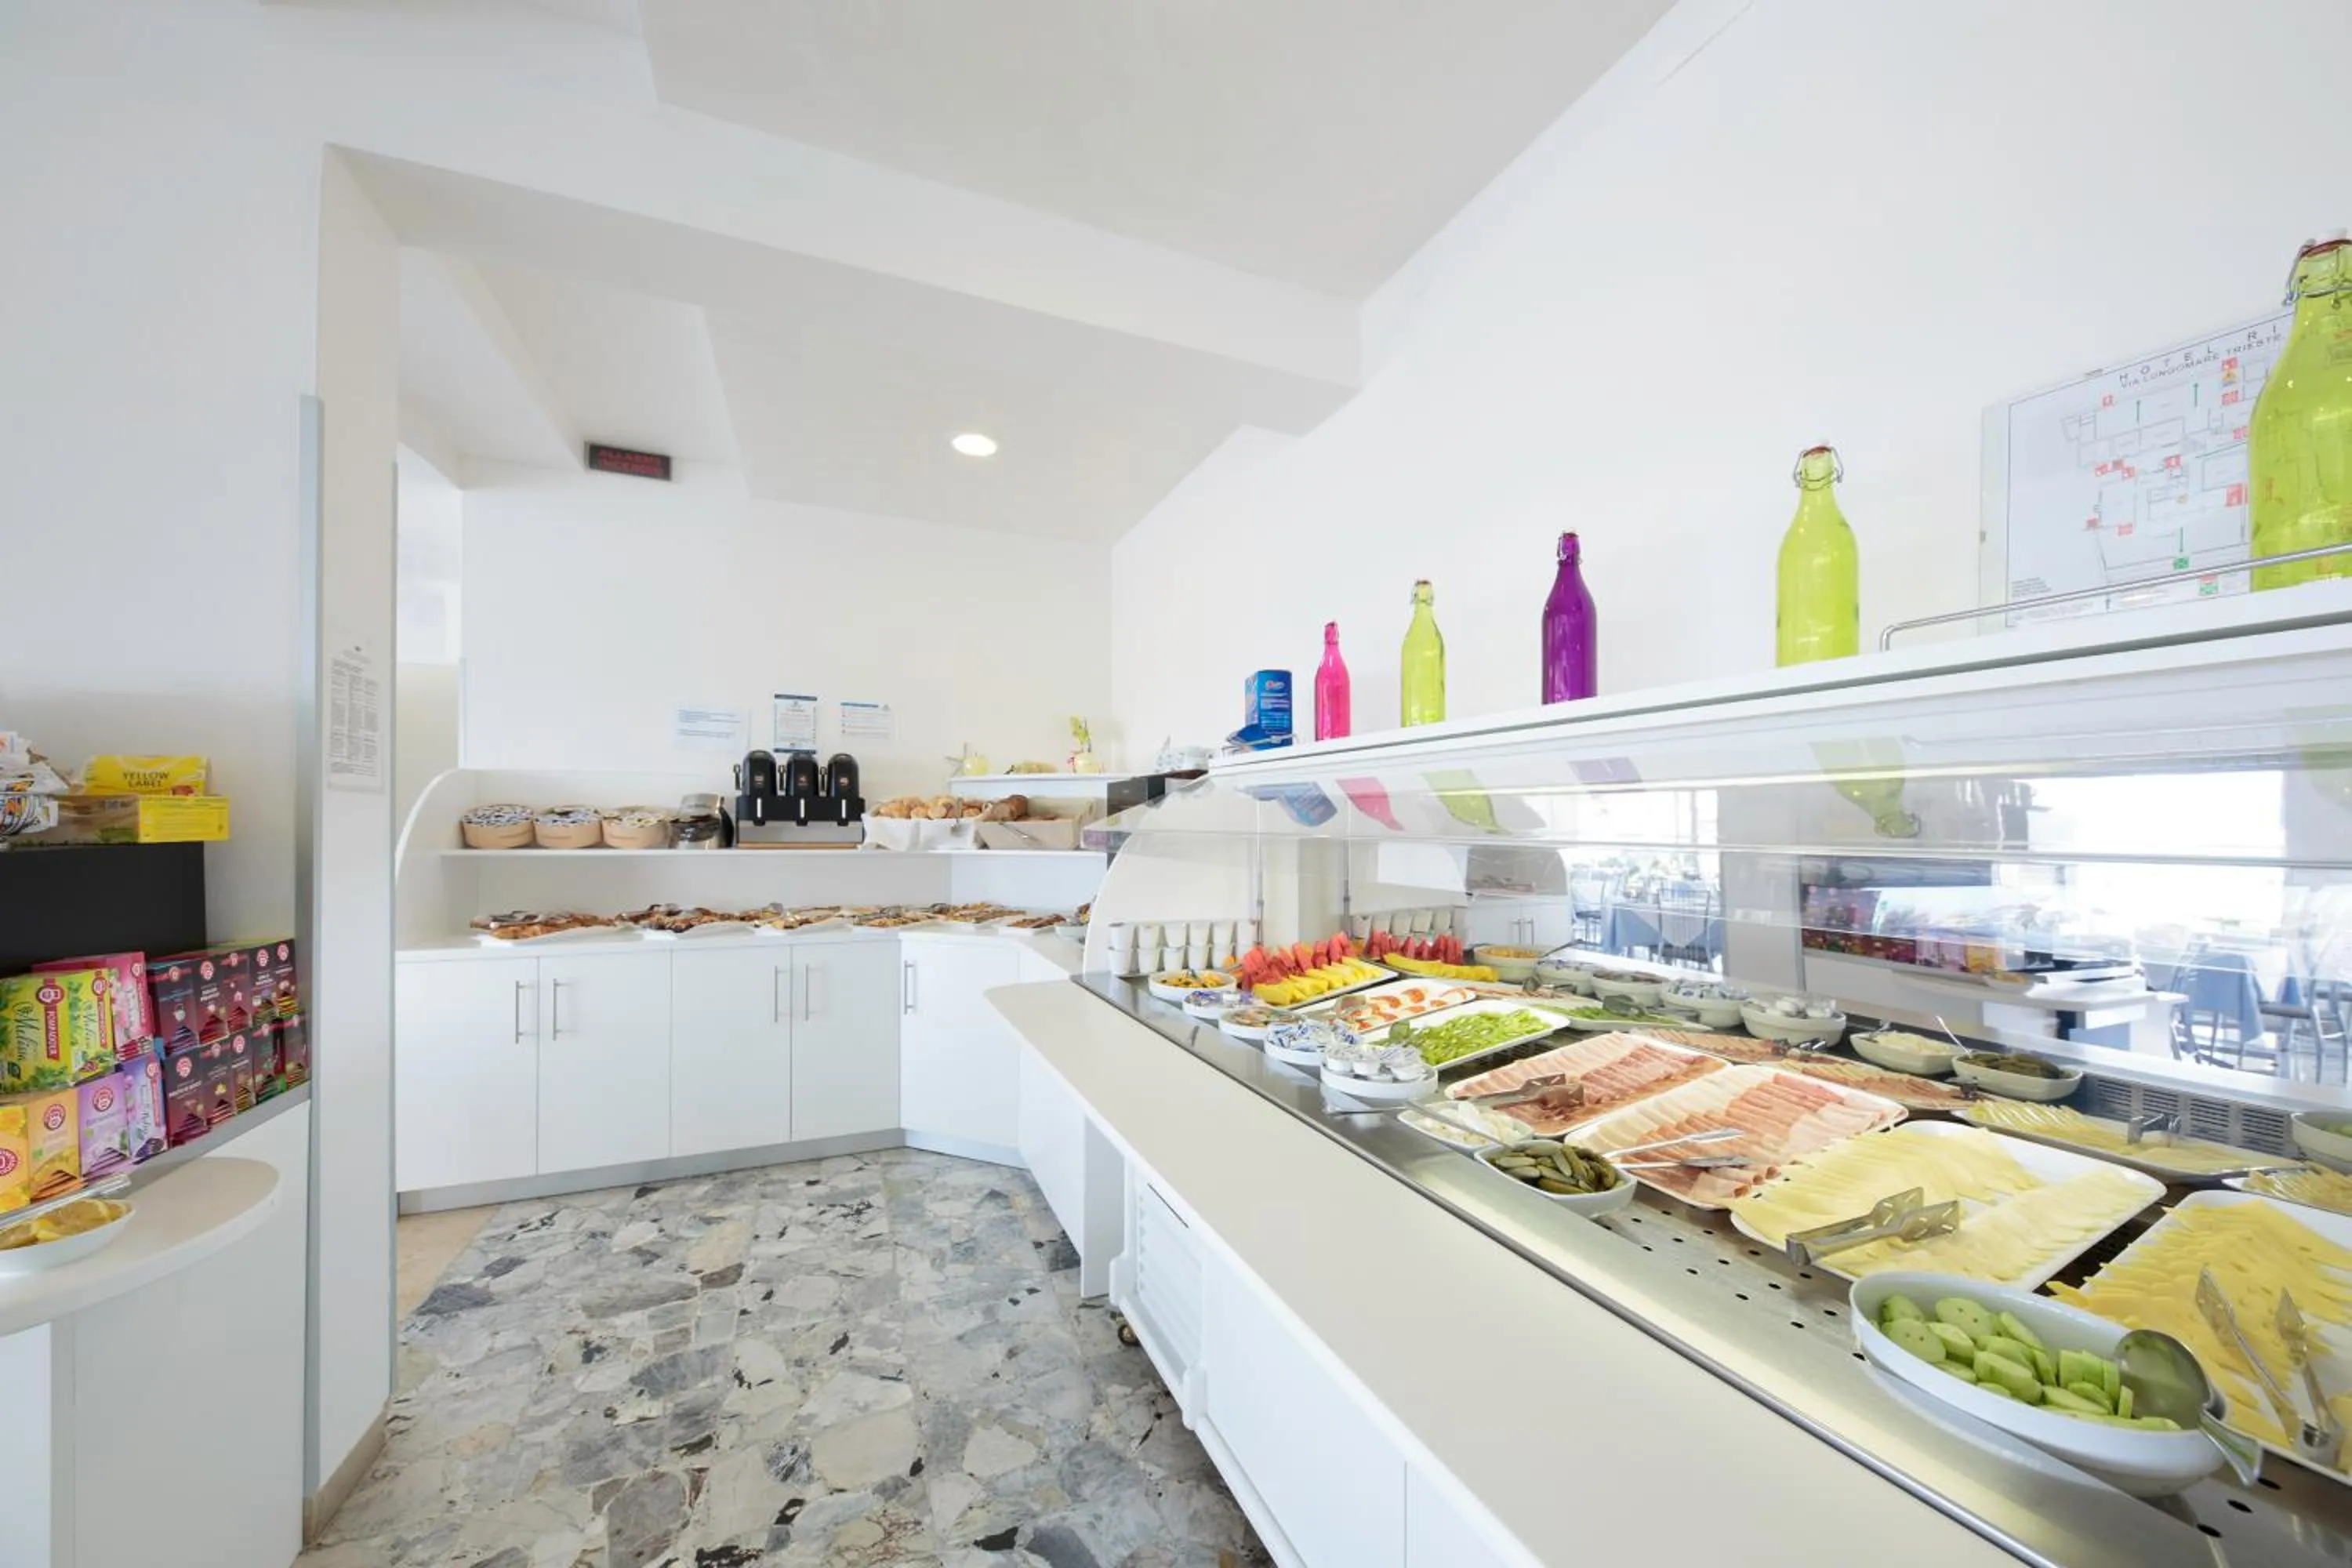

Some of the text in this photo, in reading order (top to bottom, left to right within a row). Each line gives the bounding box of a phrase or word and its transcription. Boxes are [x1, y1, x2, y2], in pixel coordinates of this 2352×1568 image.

[2119, 325, 2277, 383] HOTEL RI
[2122, 378, 2140, 390] VIA
[2143, 354, 2220, 383] LUNGOMARE
[122, 771, 170, 780] YELLOW
[128, 779, 163, 789] LABEL
